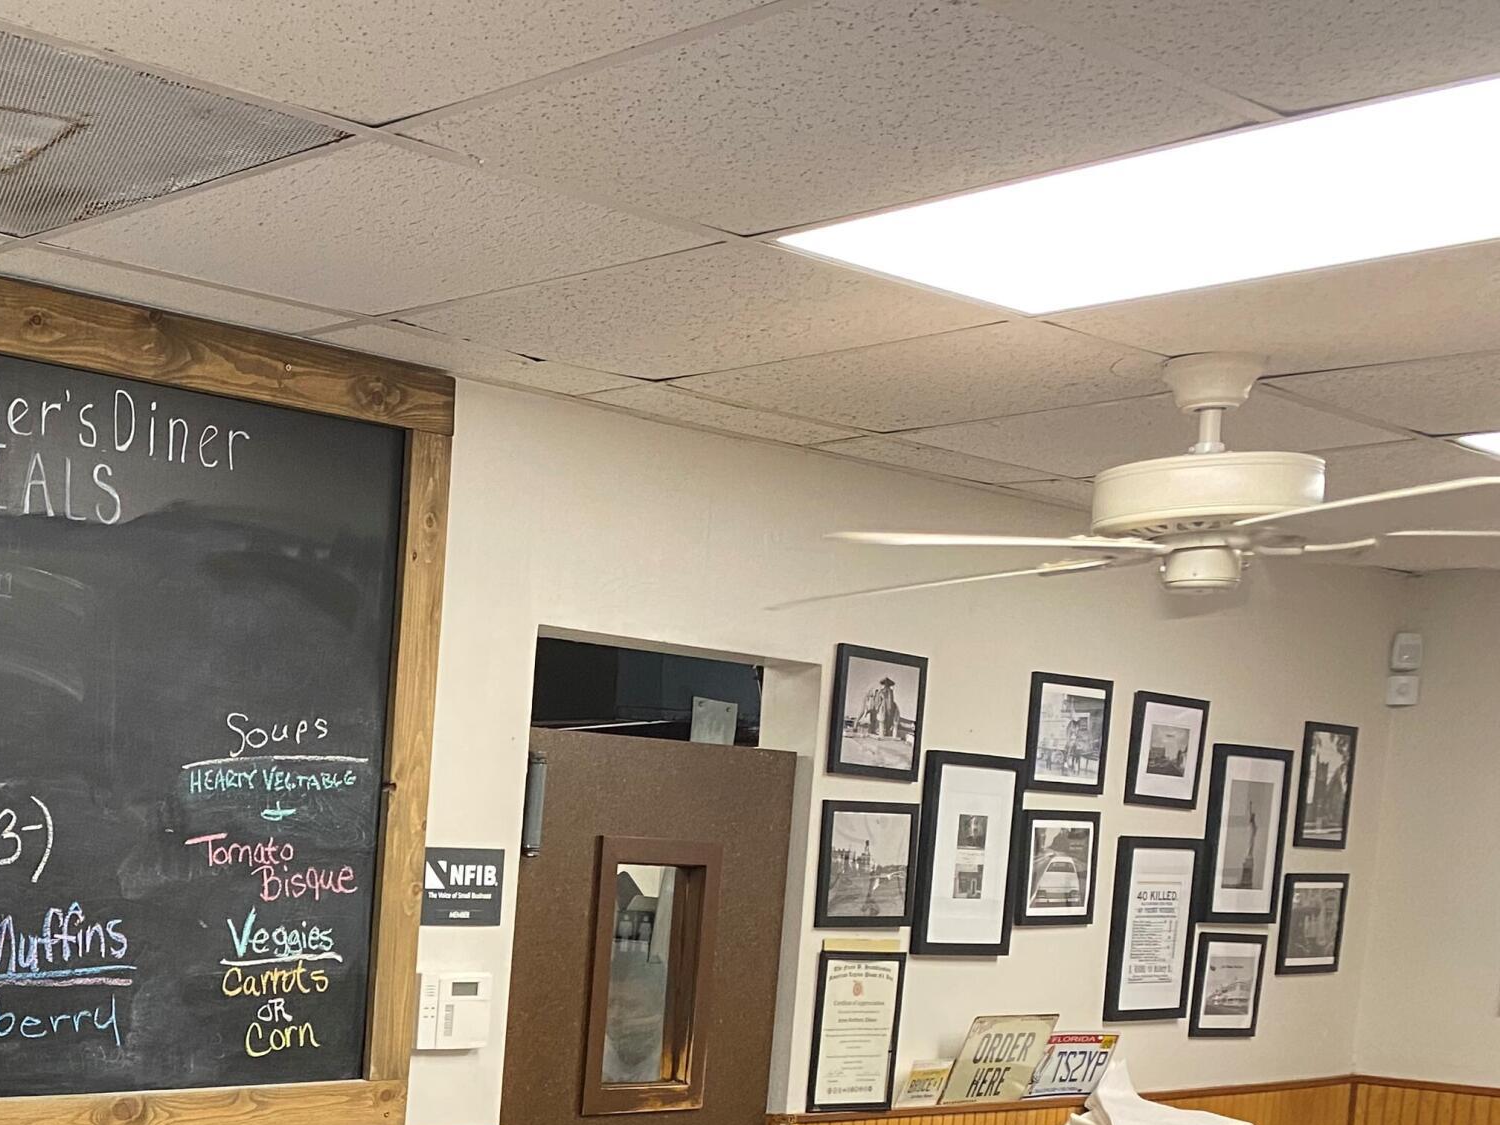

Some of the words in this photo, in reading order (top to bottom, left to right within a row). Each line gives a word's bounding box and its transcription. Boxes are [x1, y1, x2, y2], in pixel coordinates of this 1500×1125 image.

[113, 389, 251, 471] Diner
[226, 712, 329, 758] Soups
[188, 768, 258, 794] HEARTY
[185, 832, 295, 867] Tomato
[250, 863, 358, 901] Bisque
[449, 864, 498, 887] NFIB
[1136, 891, 1148, 901] 40
[227, 905, 335, 959] Veggies
[221, 959, 329, 998] Carrots
[257, 998, 294, 1023] OR
[244, 1021, 322, 1058] Corn
[971, 1032, 1037, 1065] ORDER
[1051, 1035, 1097, 1044] FLORIDA
[966, 1066, 1012, 1098] HERE
